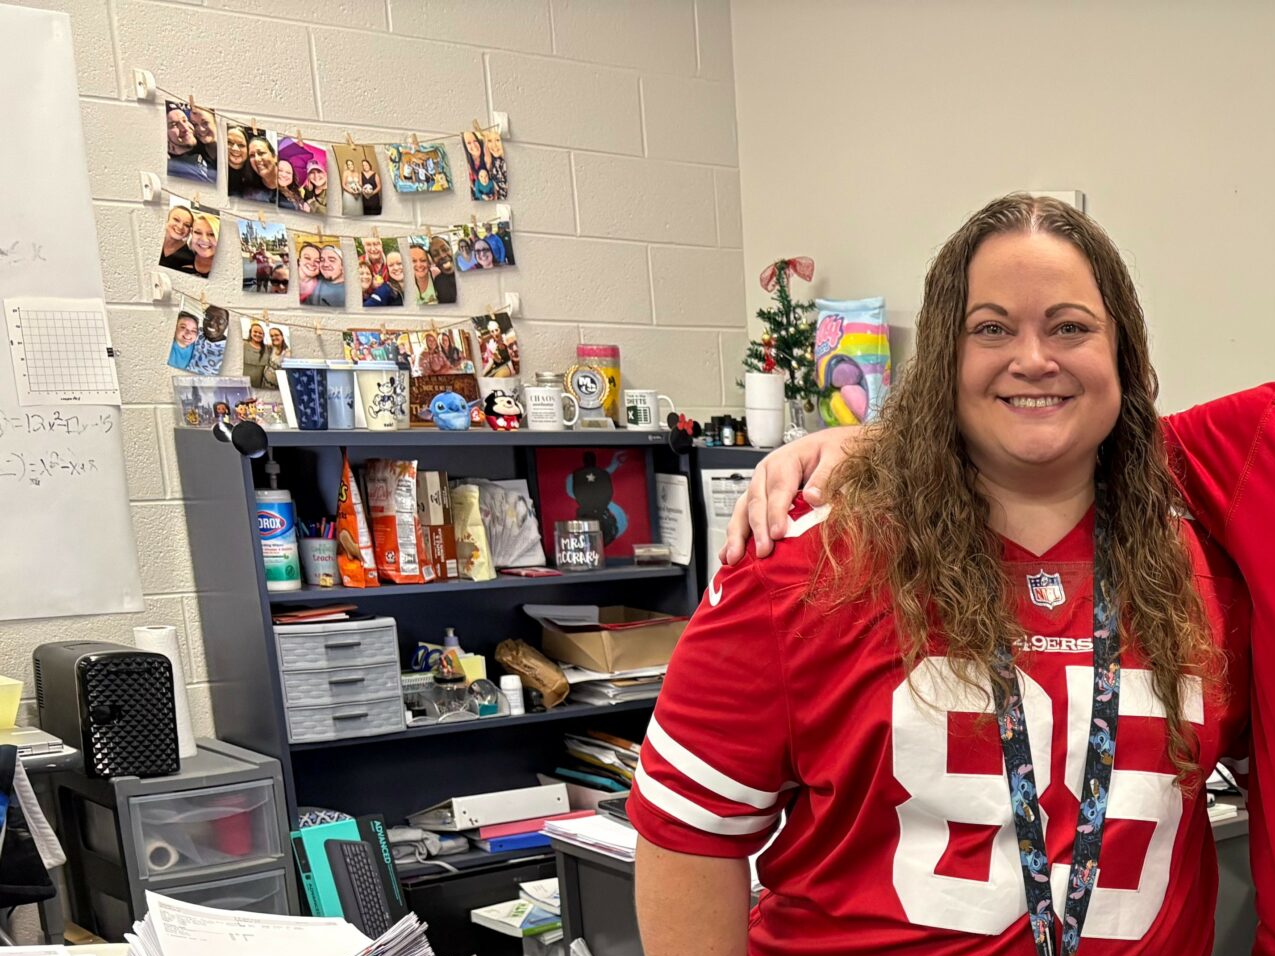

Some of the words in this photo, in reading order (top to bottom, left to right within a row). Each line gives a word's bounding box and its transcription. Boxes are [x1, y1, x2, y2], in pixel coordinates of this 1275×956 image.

[258, 517, 281, 529] OROX
[561, 535, 585, 550] MRS
[1034, 586, 1061, 601] NFL
[1012, 635, 1094, 653] 49ERS
[893, 656, 1204, 940] 85
[374, 820, 391, 864] ADVANCED
